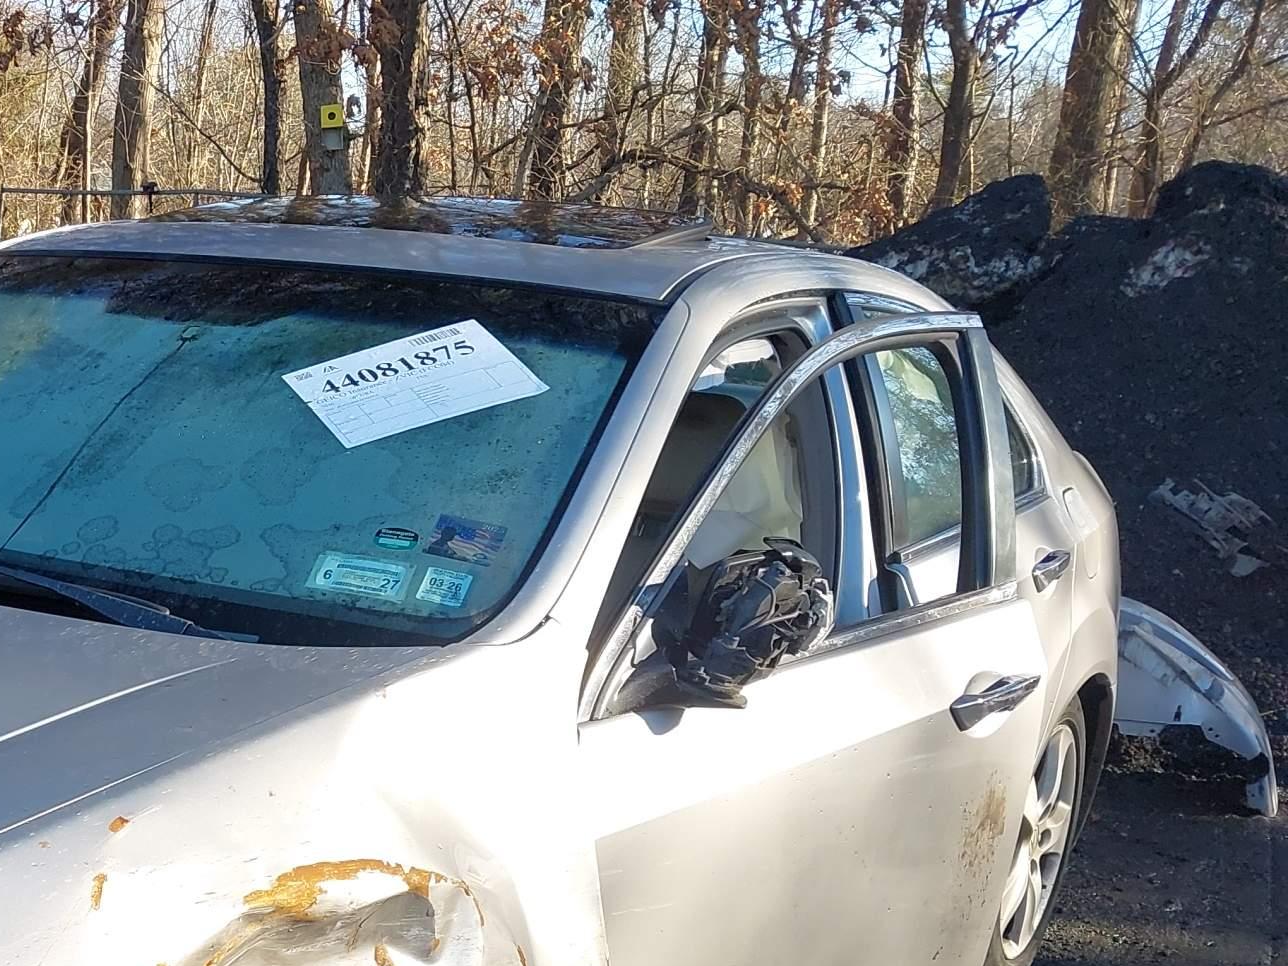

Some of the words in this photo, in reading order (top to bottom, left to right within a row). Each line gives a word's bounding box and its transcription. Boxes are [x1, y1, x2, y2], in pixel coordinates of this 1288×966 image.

[320, 339, 475, 395] 44081875
[323, 569, 334, 580] 6
[380, 578, 401, 590] 27
